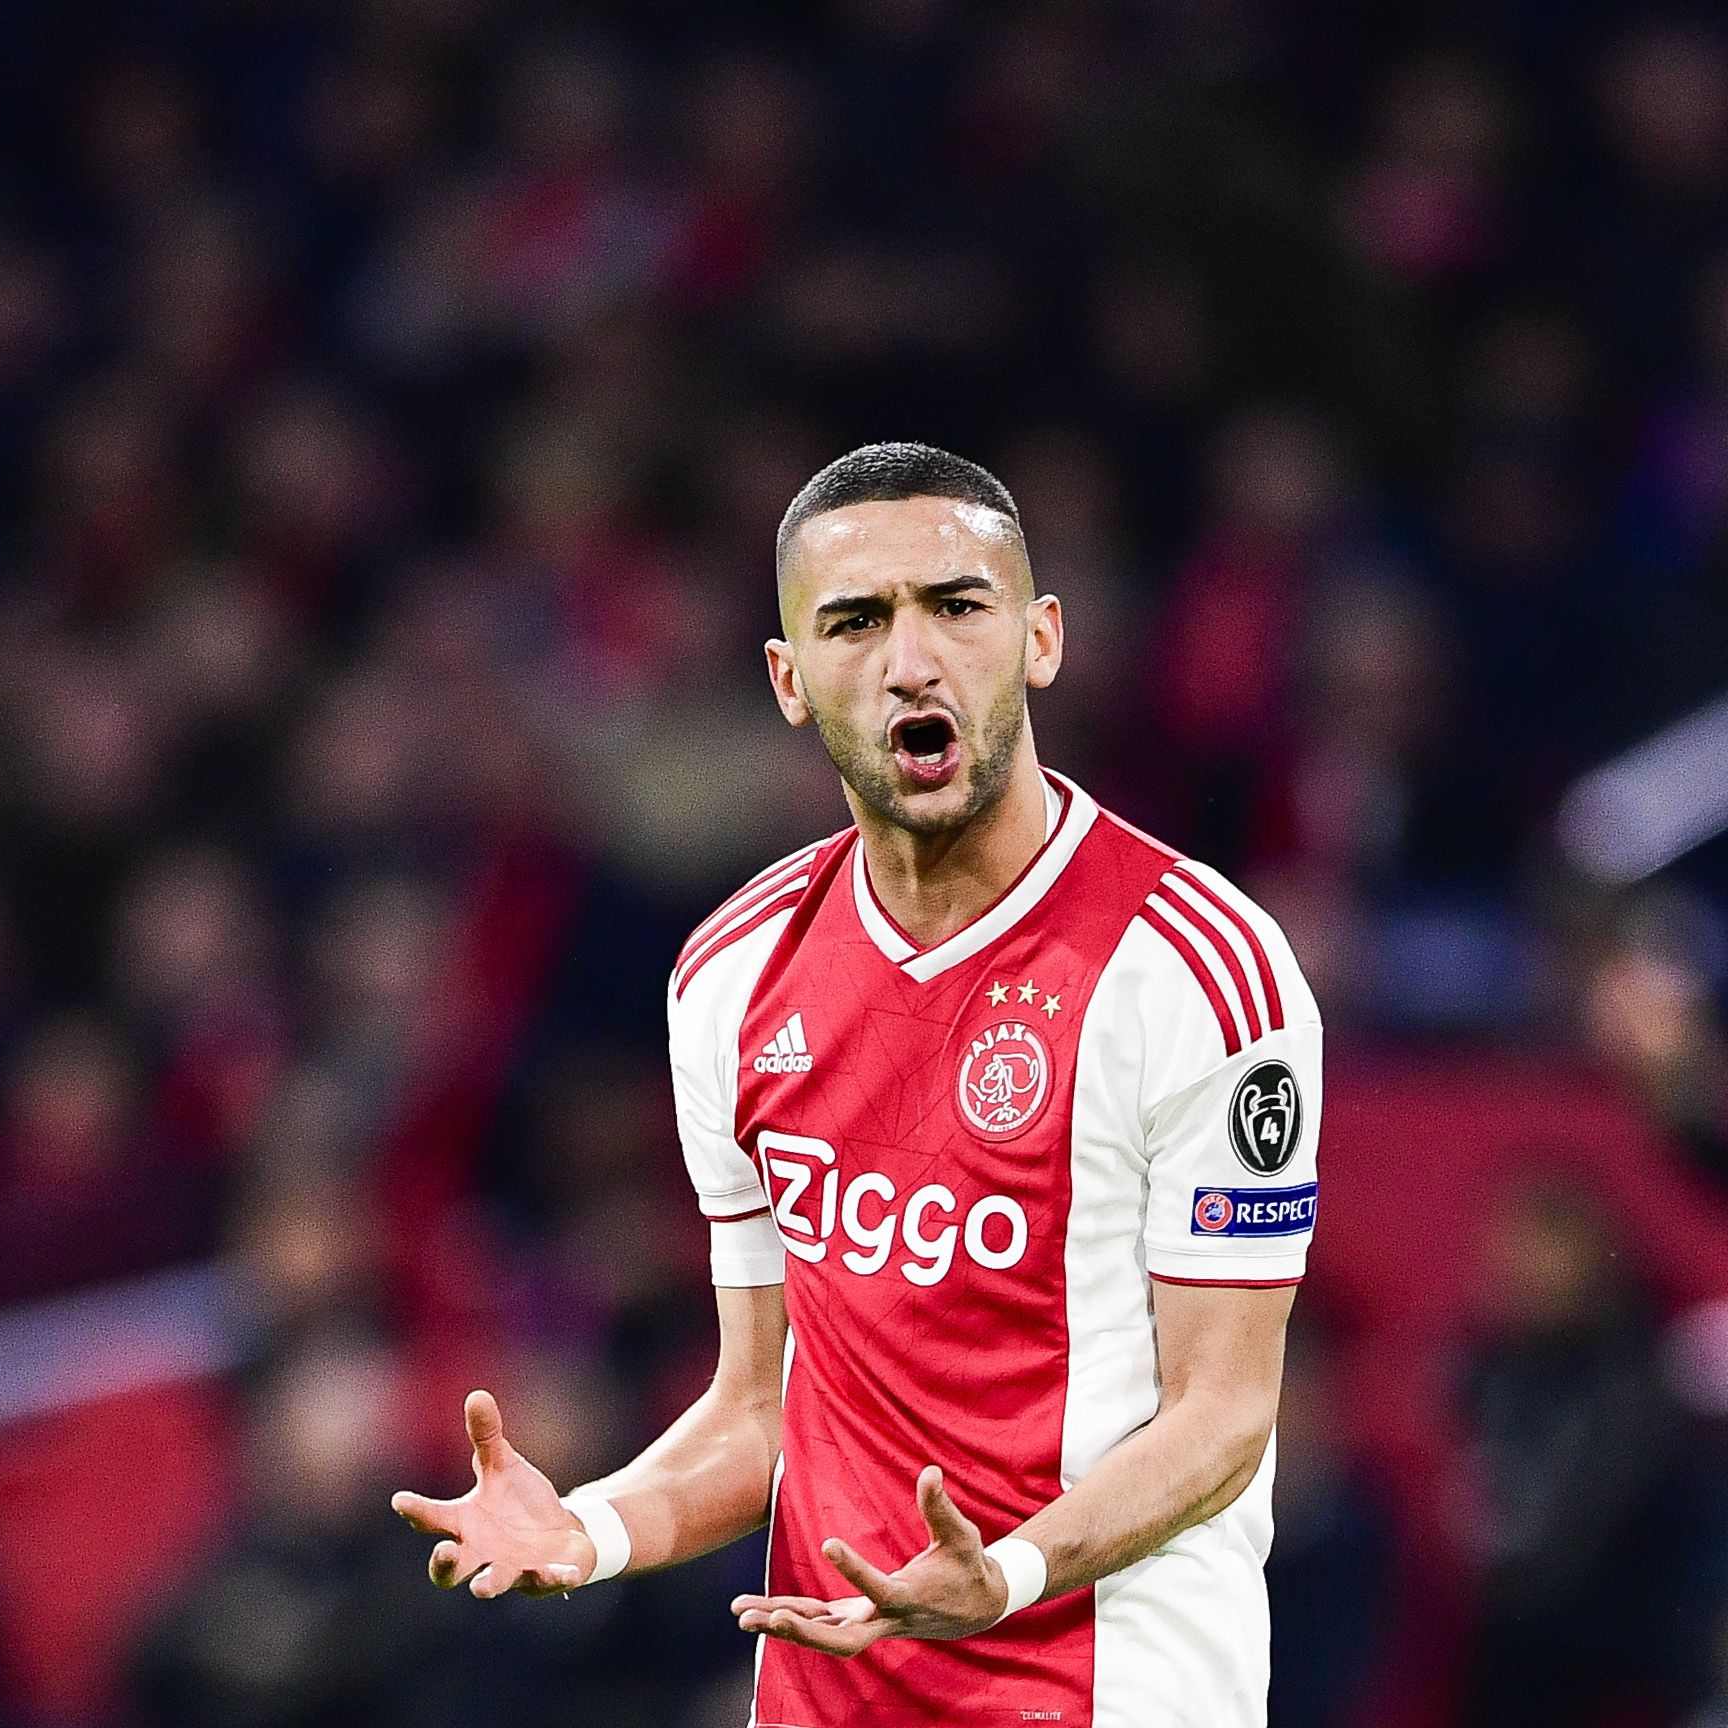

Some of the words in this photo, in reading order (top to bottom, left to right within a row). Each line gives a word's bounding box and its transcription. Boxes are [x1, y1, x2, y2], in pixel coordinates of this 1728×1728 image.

[971, 1023, 1026, 1059] AJAX
[753, 1053, 814, 1074] adidas
[1260, 1116, 1281, 1145] 4
[1236, 1196, 1316, 1224] RESPECT
